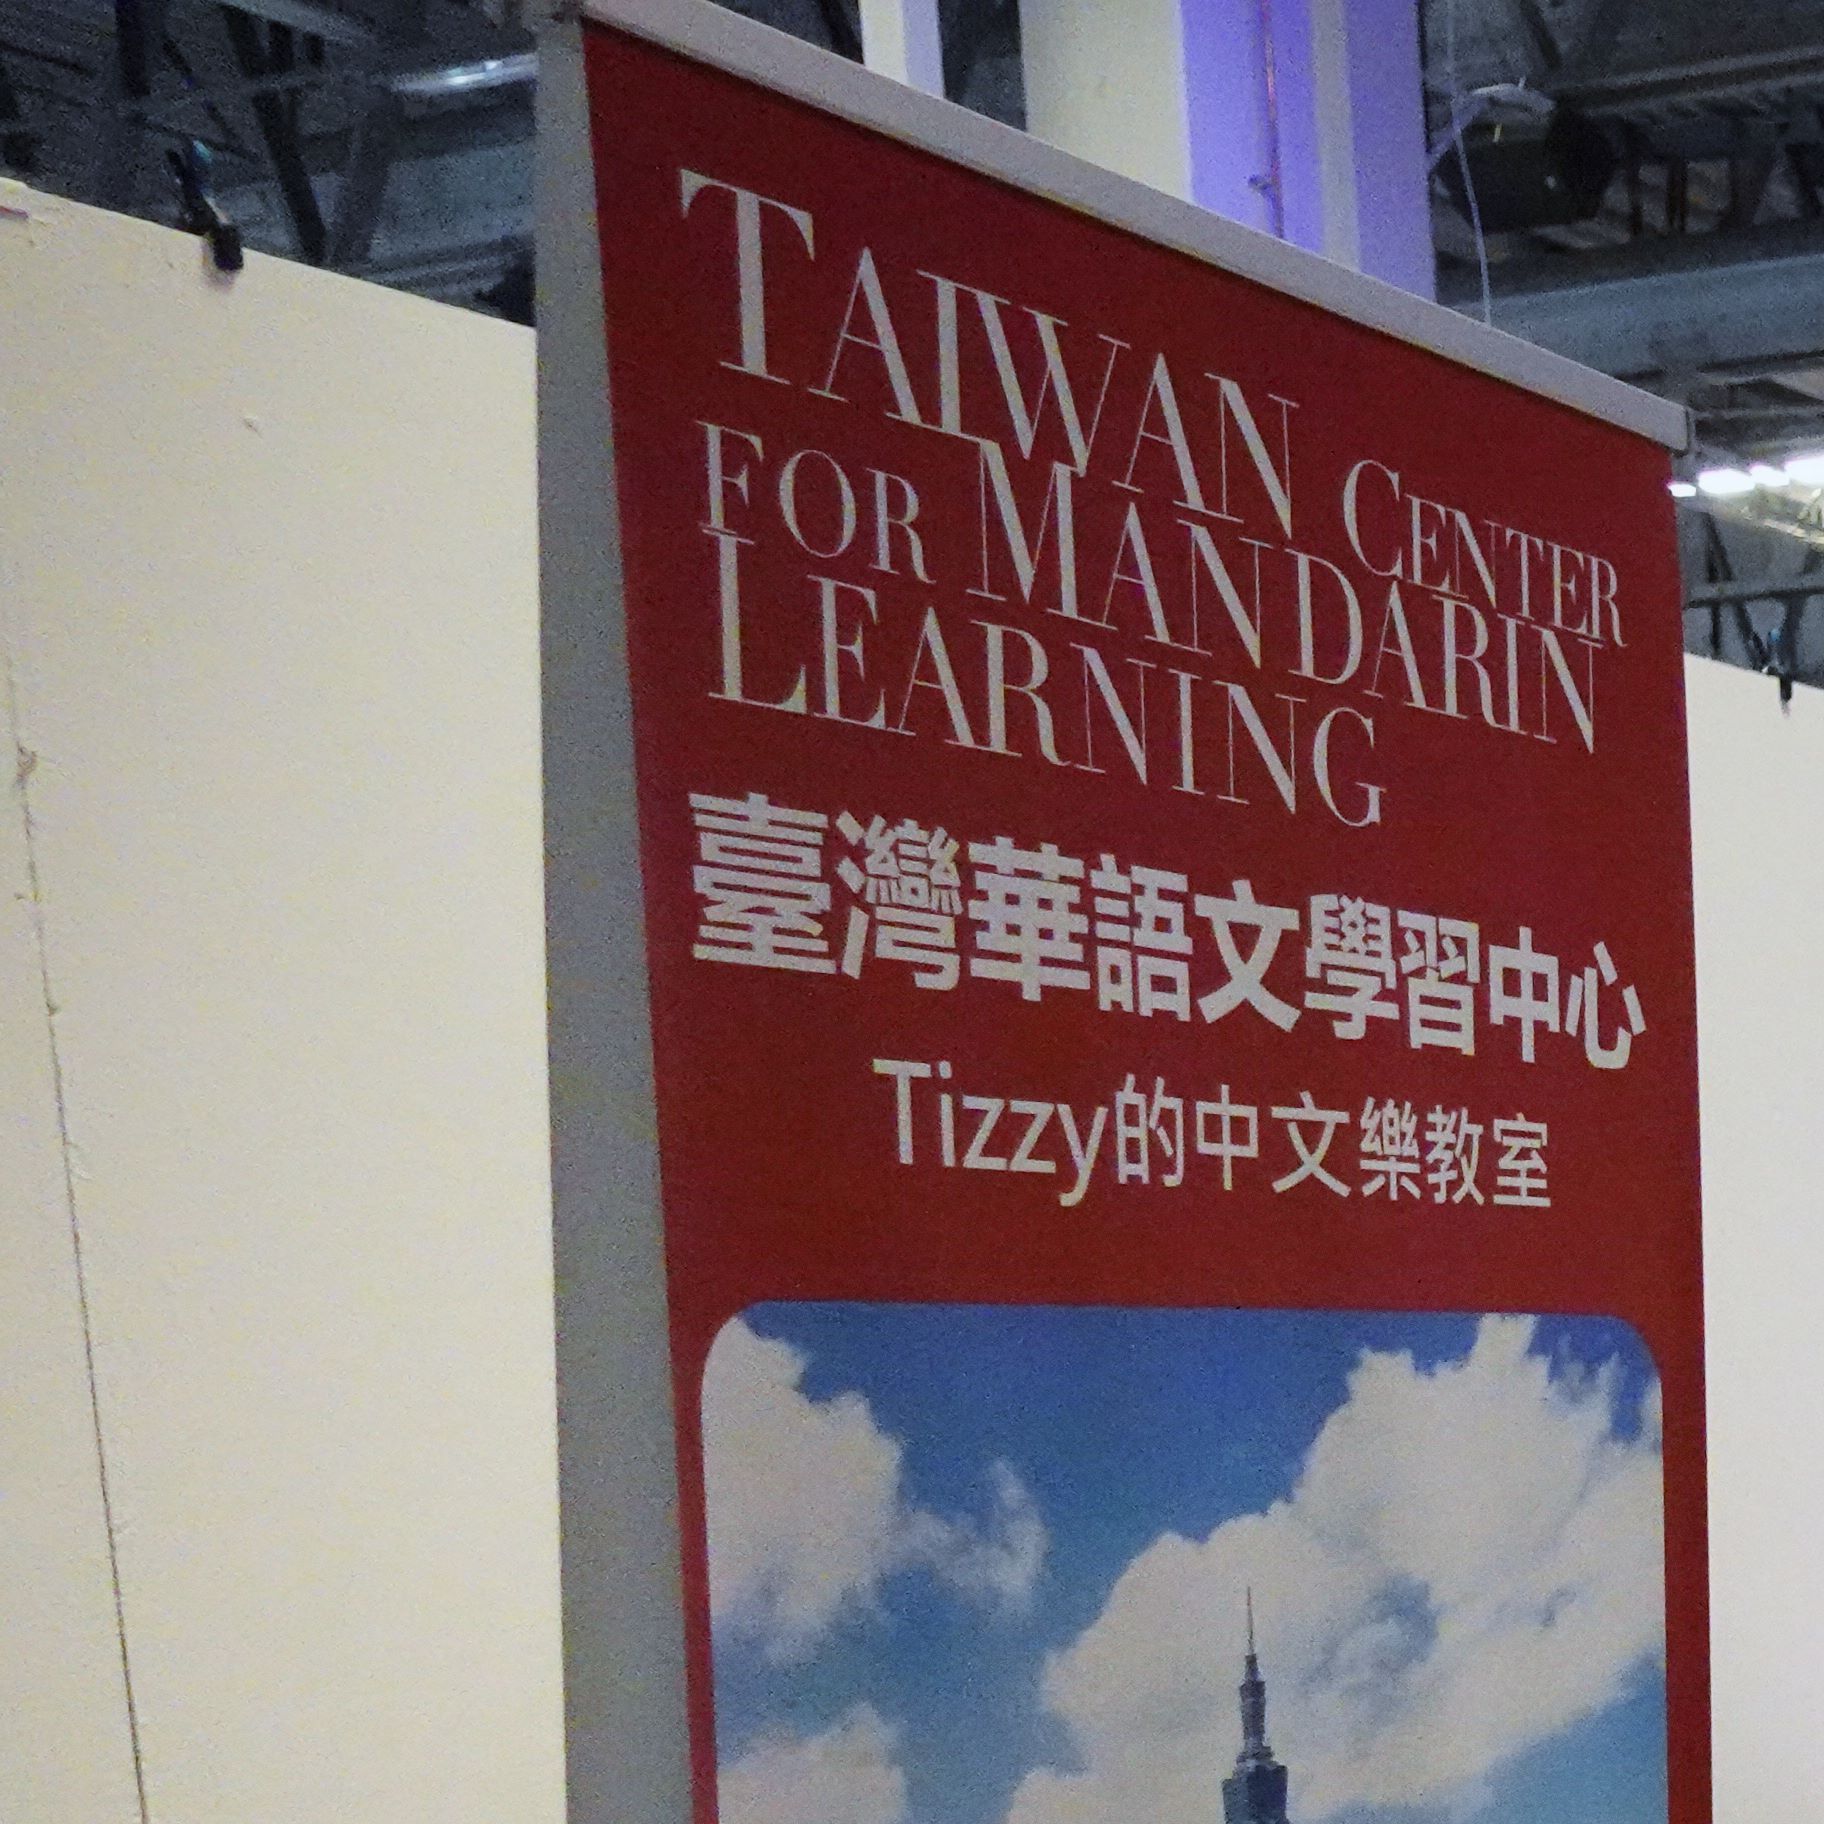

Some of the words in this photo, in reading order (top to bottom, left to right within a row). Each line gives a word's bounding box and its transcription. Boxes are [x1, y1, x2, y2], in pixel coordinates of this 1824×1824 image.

[679, 168, 1300, 540] TAIWAN
[1341, 458, 1629, 648] CENTER
[695, 420, 936, 585] FOR
[965, 435, 1603, 754] MANDARIN
[699, 526, 1386, 828] LEARNING
[688, 791, 1648, 1071] 臺灣華語文學習中心
[870, 1056, 1552, 1209] Tizzy的中文樂教室
